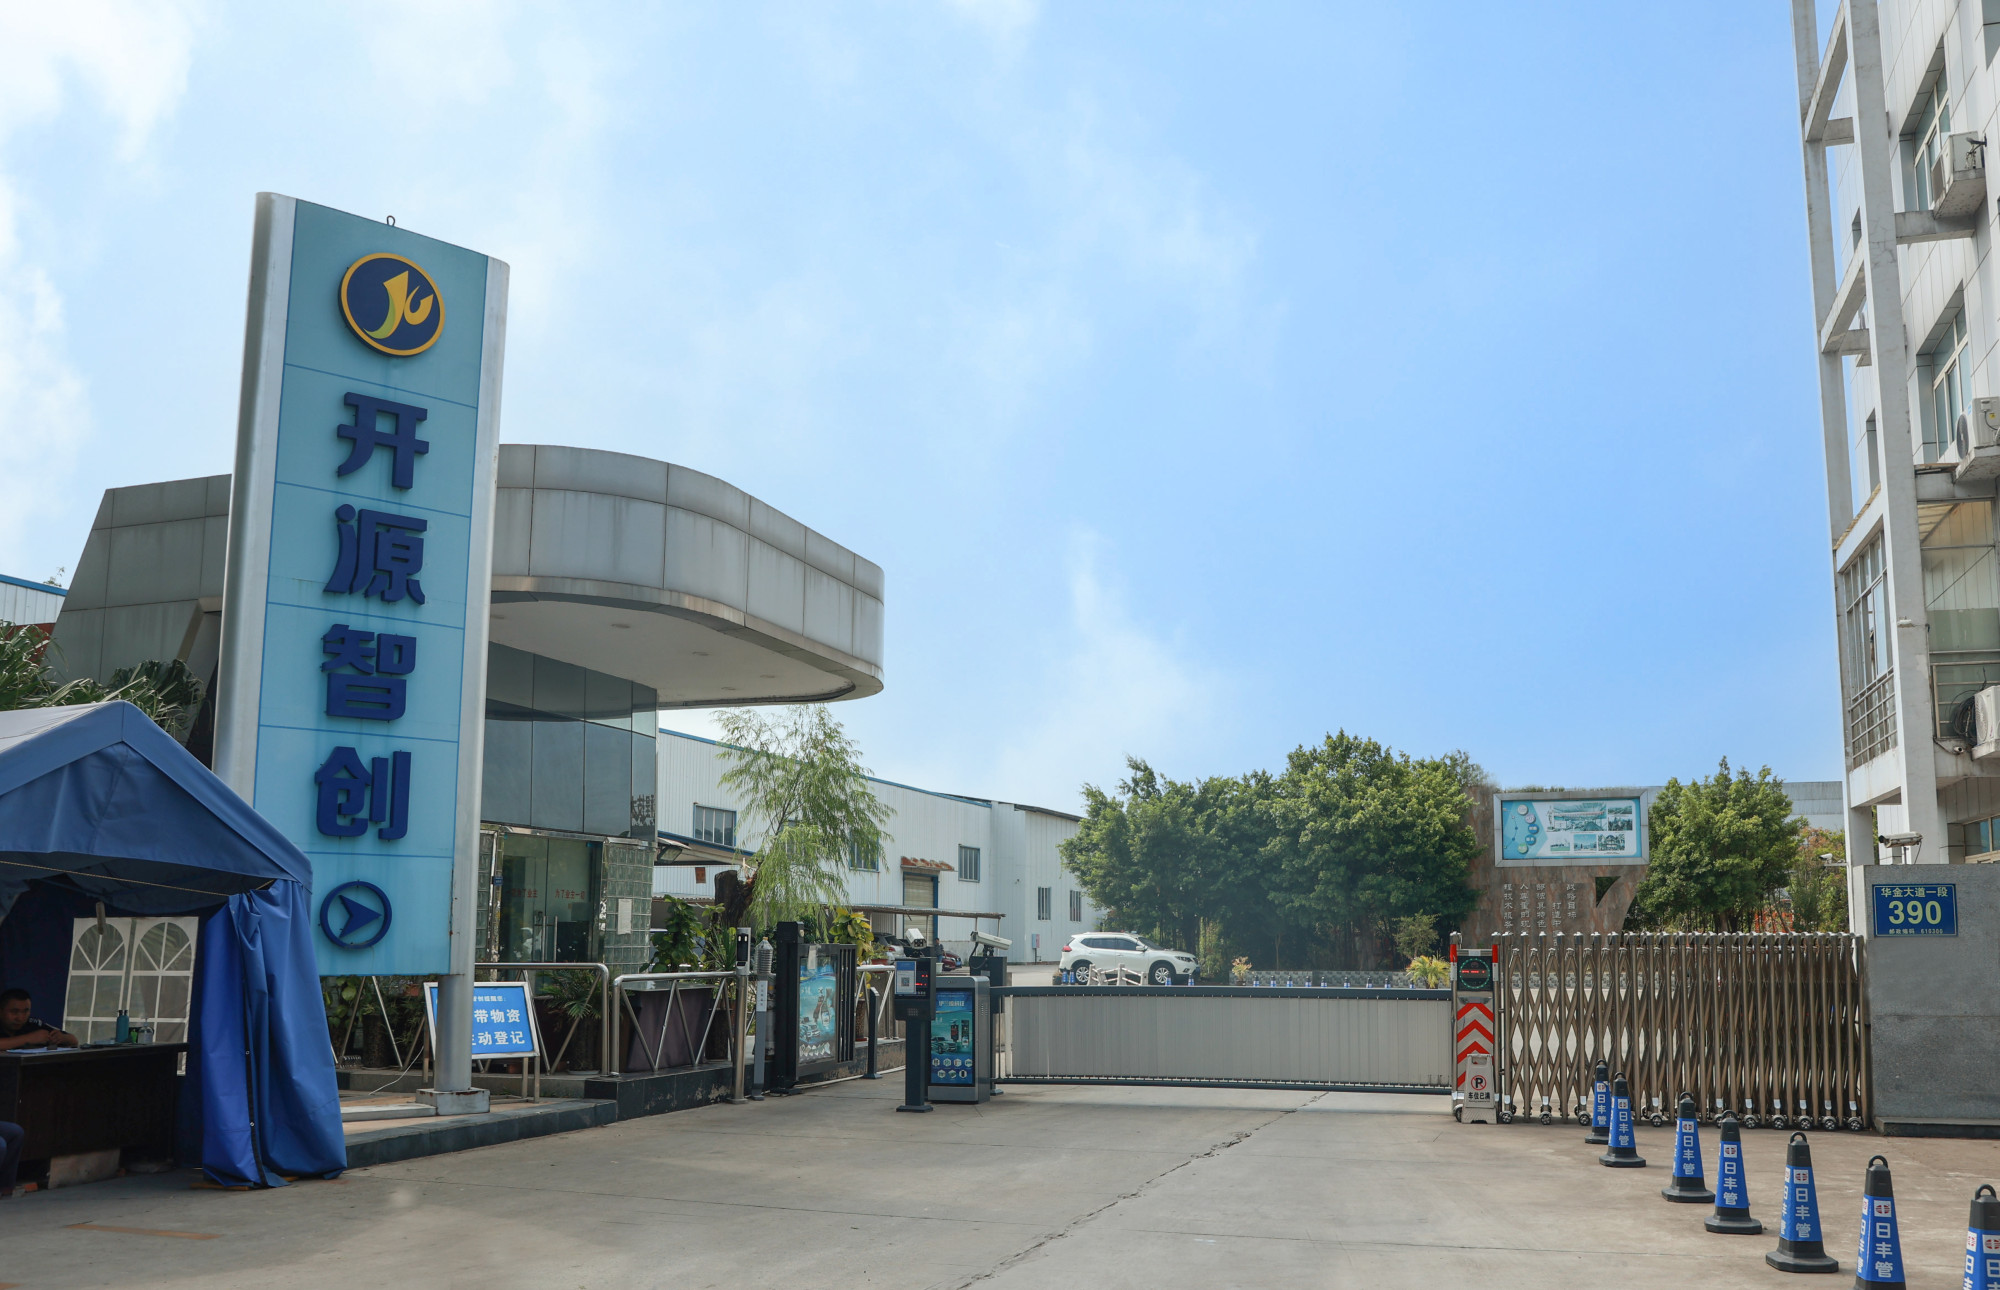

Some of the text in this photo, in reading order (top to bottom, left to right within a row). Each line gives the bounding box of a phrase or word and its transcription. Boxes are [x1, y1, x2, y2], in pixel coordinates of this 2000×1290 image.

[314, 391, 430, 840] 开源智创
[1519, 883, 1531, 933] 人尊重的现
[1566, 883, 1577, 919] 战略目标
[1881, 886, 1949, 898] 华金大道一段
[1888, 900, 1942, 925] 390
[473, 1008, 521, 1024] 带物资
[1468, 1091, 1491, 1100] 车位已满
[1597, 1094, 1607, 1125] 日丰管
[1618, 1111, 1630, 1146] 日丰管
[1682, 1135, 1696, 1175] 日丰管
[1723, 1161, 1738, 1206] 日丰管
[1795, 1187, 1811, 1238] 日丰管
[1874, 1222, 1894, 1278] 日丰管
